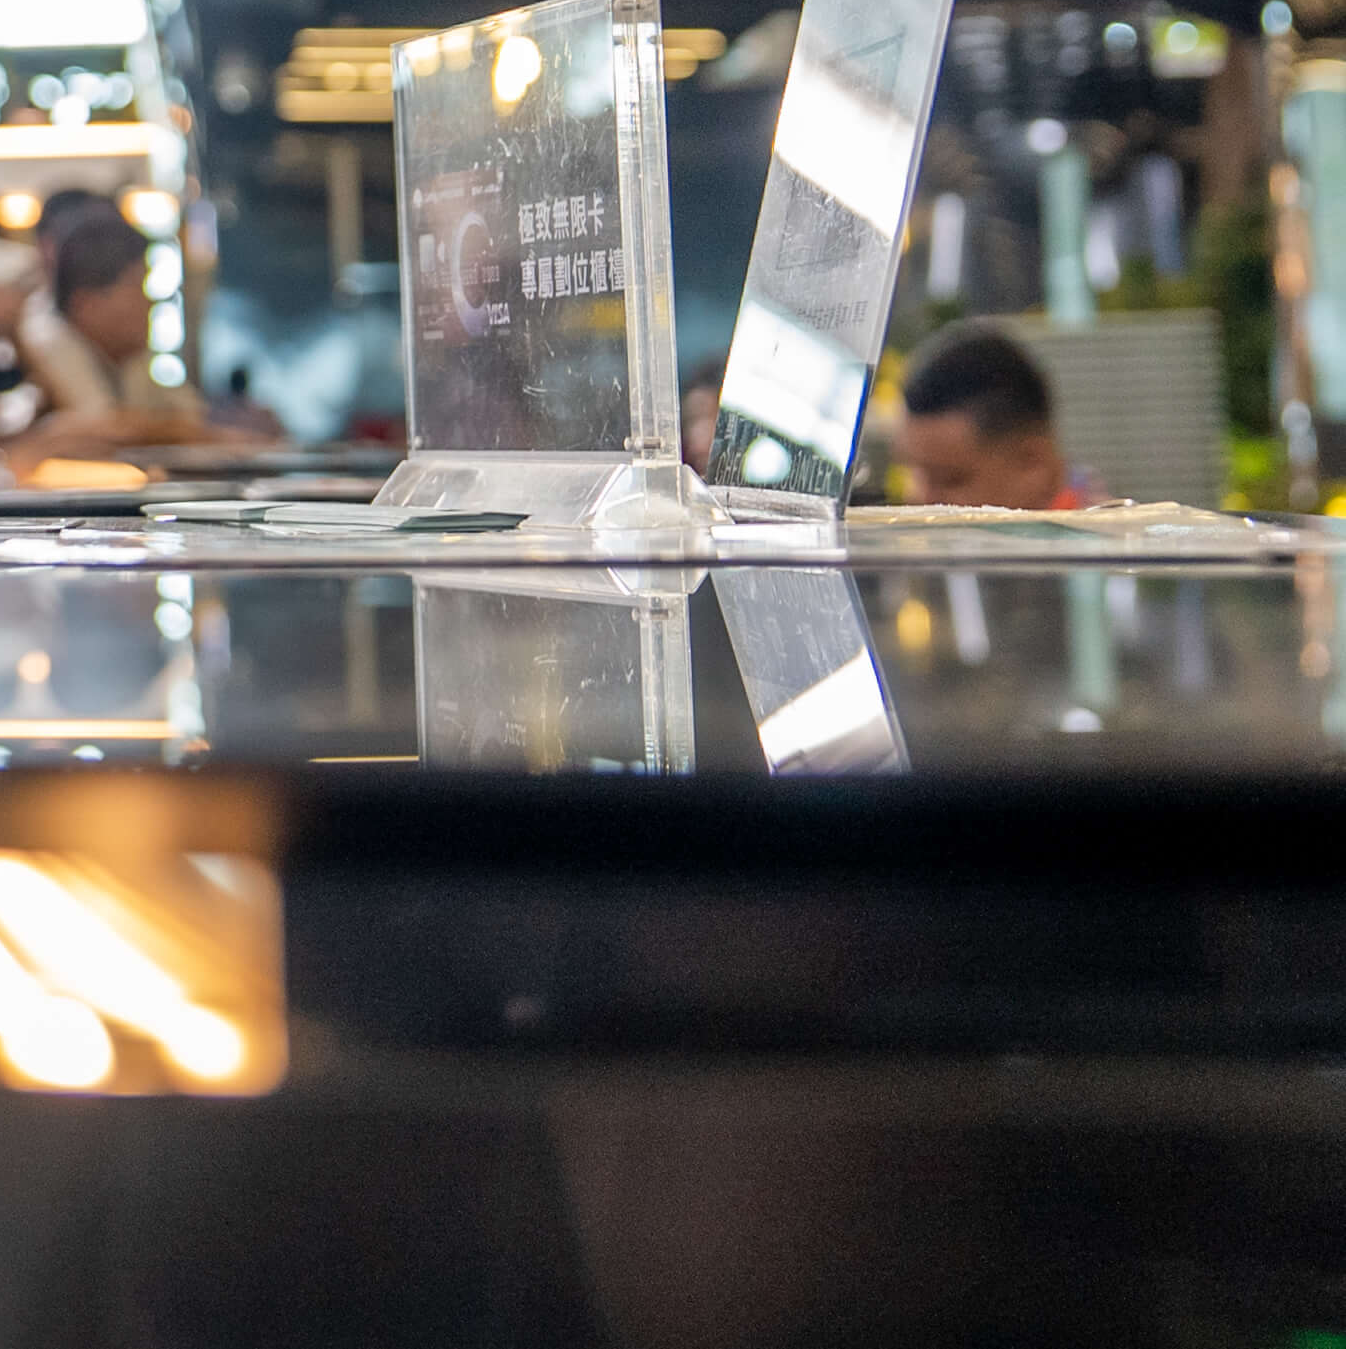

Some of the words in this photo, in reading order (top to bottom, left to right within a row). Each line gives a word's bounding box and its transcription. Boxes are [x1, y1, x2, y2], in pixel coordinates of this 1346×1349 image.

[518, 192, 604, 244] 極致無限卡
[486, 303, 510, 325] VISA
